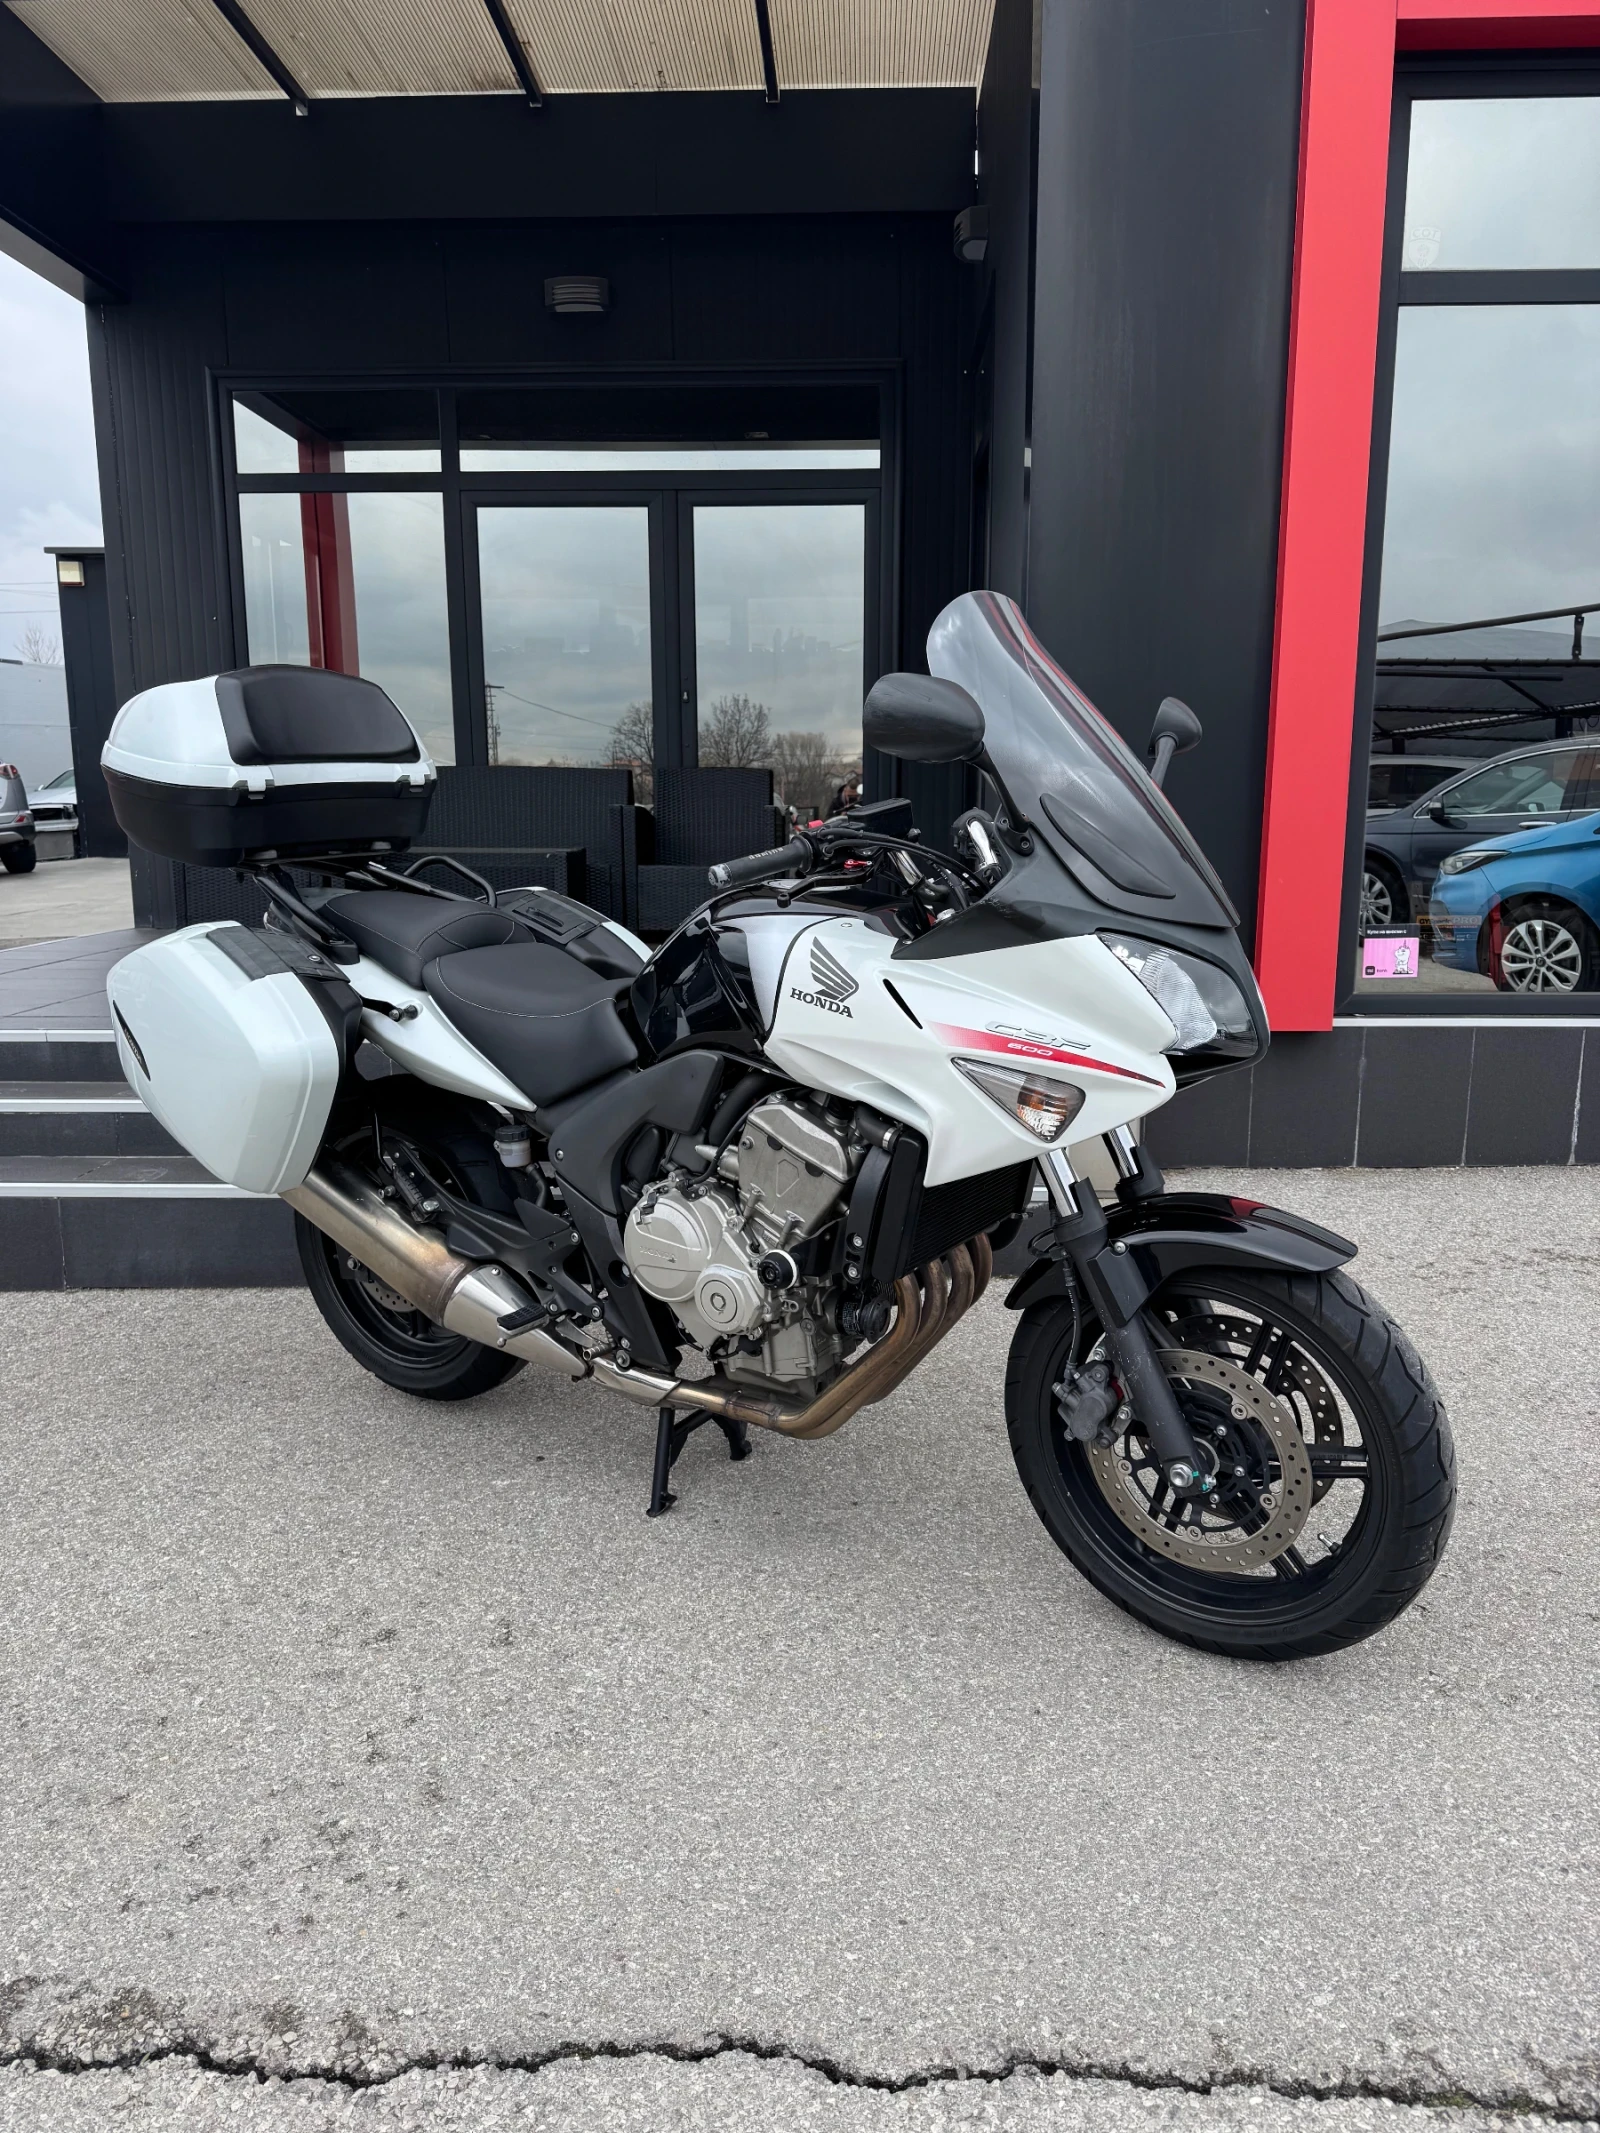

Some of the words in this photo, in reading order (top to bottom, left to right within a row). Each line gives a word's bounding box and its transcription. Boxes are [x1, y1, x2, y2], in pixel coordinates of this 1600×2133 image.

[1453, 916, 1478, 924] PRO
[790, 987, 854, 1019] HONDA
[985, 1020, 1092, 1051] CBF
[1007, 1042, 1053, 1056] 600
